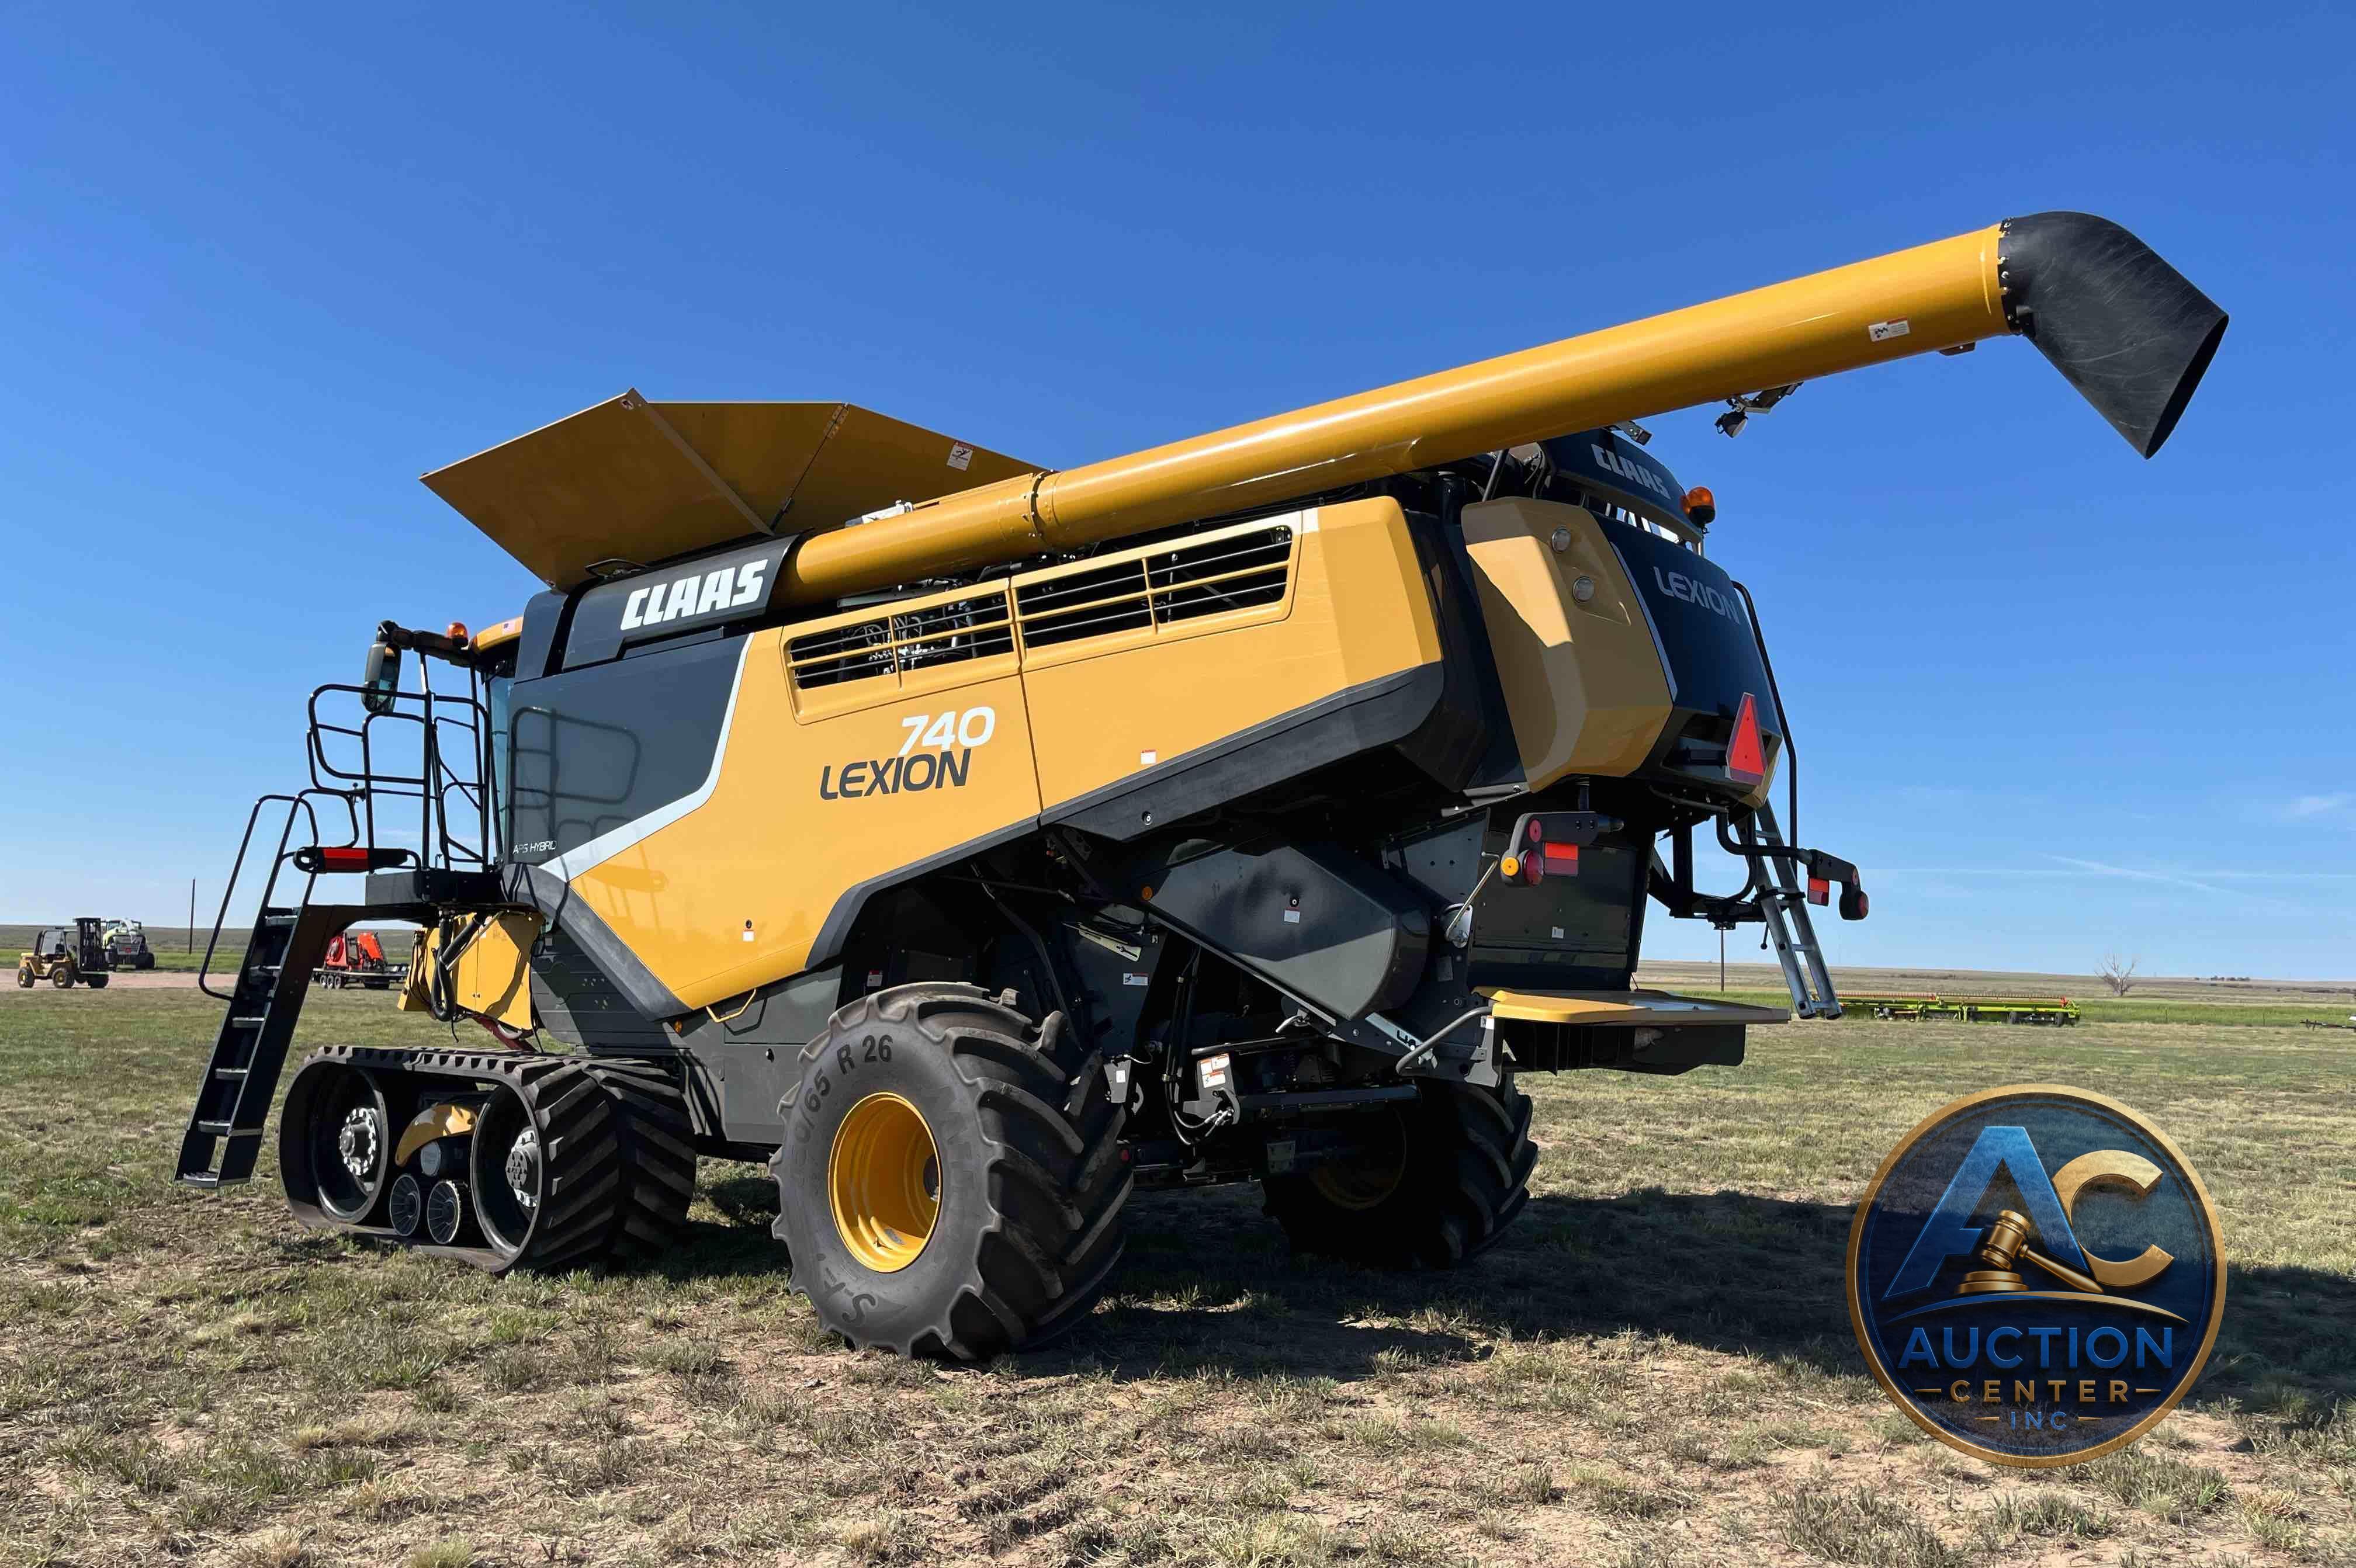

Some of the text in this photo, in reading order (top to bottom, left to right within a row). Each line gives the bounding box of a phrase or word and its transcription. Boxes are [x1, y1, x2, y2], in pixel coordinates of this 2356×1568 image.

[1591, 444, 1671, 499] CLAAS
[621, 559, 768, 630] CLAAS
[1654, 567, 1741, 625] LEXION
[899, 706, 995, 756] 740
[820, 748, 972, 800] LEXION
[837, 1044, 855, 1075] R
[862, 1035, 893, 1062] 26
